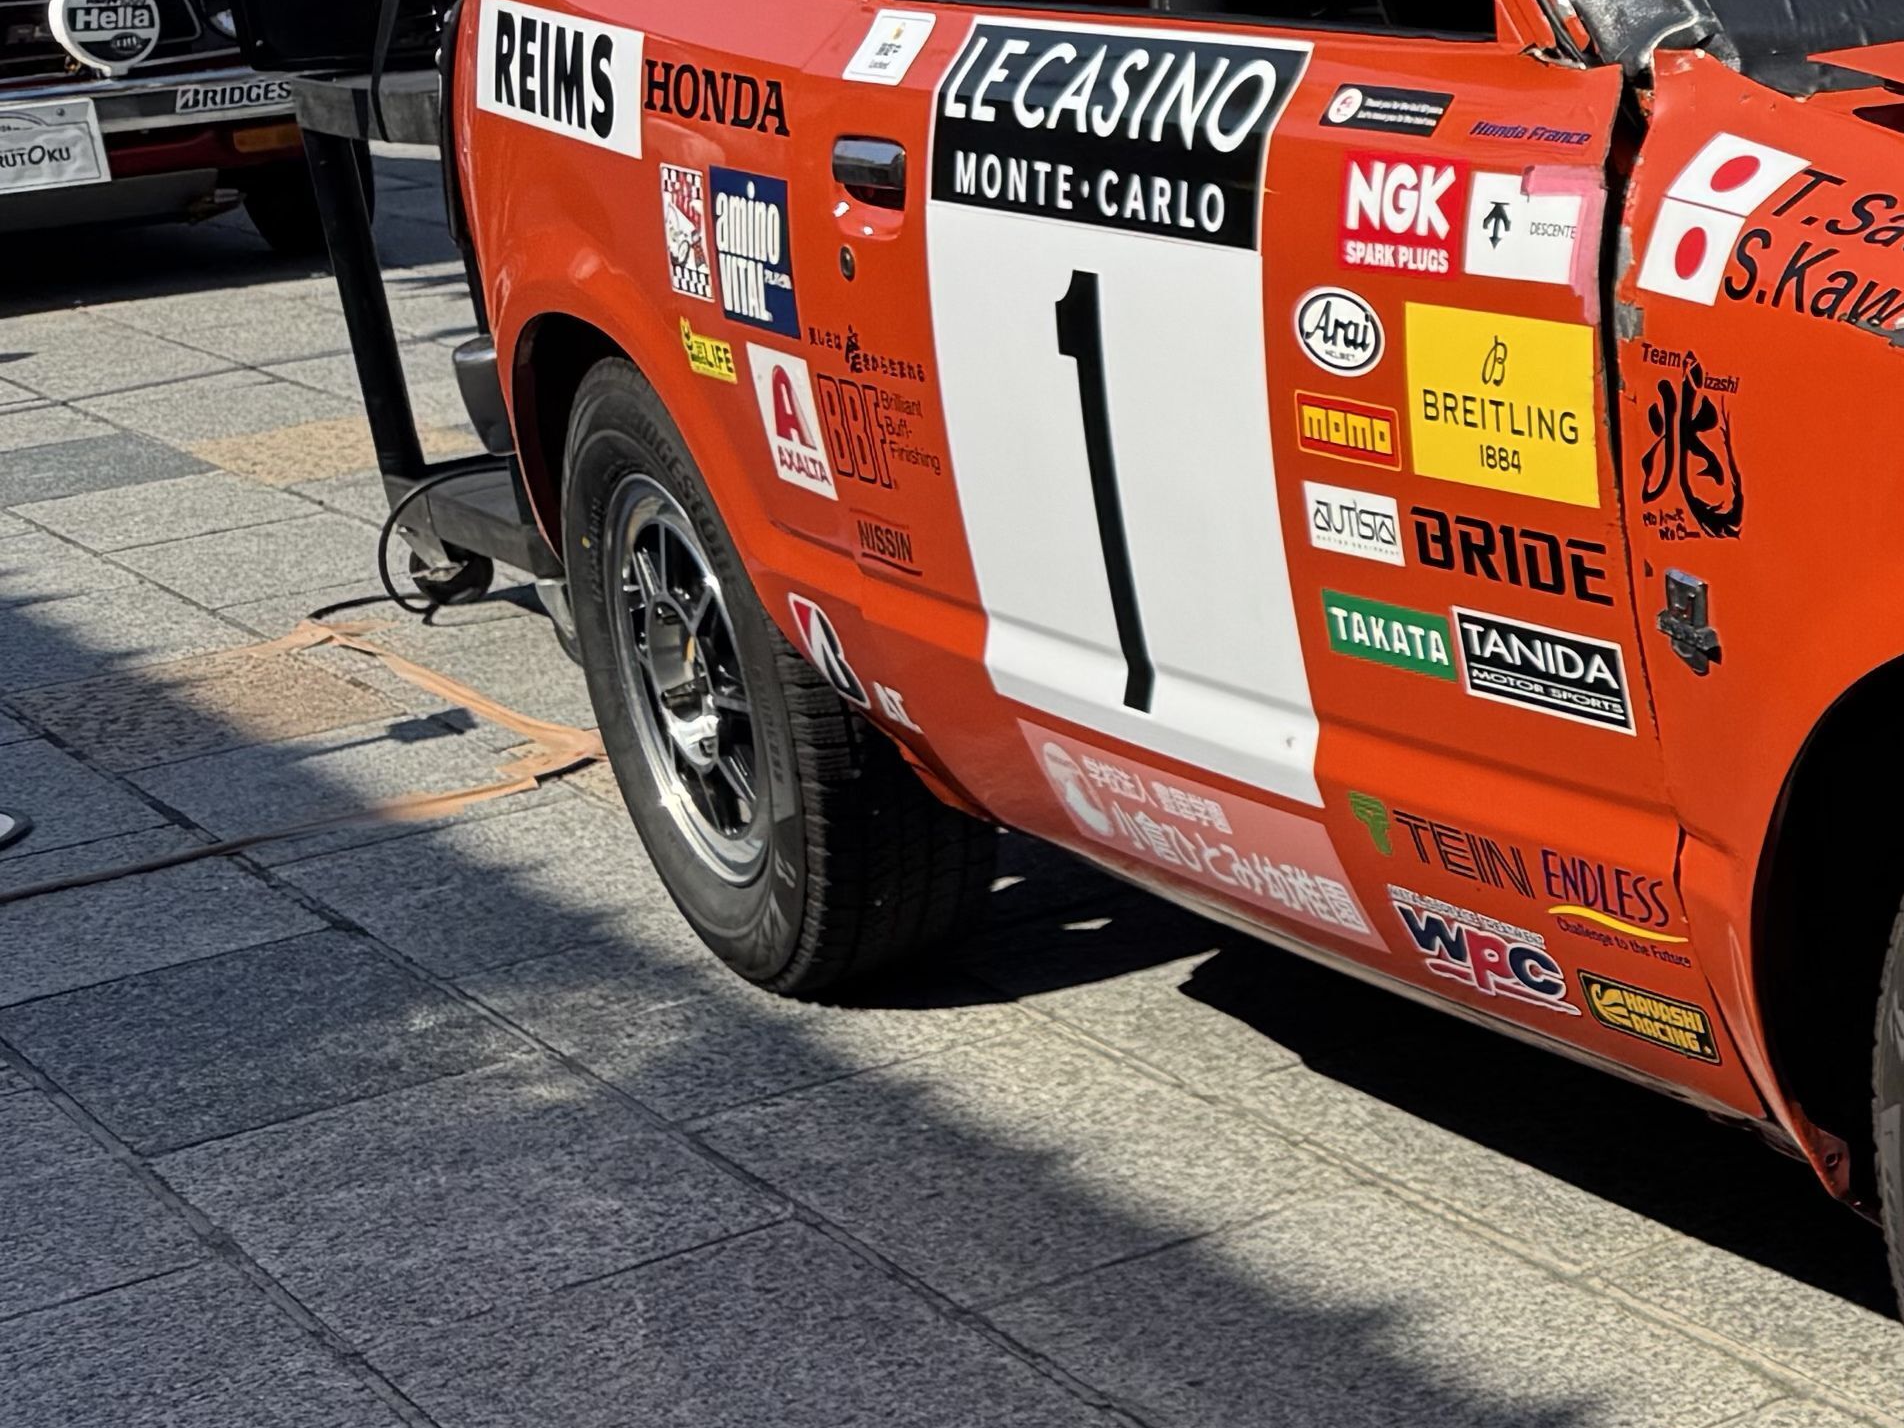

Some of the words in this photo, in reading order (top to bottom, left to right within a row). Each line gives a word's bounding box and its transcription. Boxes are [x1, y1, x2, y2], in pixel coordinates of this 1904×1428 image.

[76, 6, 150, 30] Hella
[180, 80, 291, 110] BRIDGES
[494, 9, 615, 140] REIMS
[644, 59, 790, 137] HONDA
[1469, 120, 1528, 141] Honda
[1529, 126, 1592, 147] France
[716, 180, 780, 265] amino
[1347, 160, 1456, 240] NGK
[1345, 240, 1394, 269] SPARK
[1397, 245, 1449, 274] PLUGS
[1530, 221, 1576, 240] DESCENTE
[720, 253, 773, 322] VITAL
[1305, 300, 1370, 352] Arai
[1641, 343, 1681, 368] Team
[816, 372, 893, 489] BBF
[880, 391, 923, 418] Brilliant
[1423, 389, 1579, 445] BREITLING
[778, 446, 831, 486] AXALTA
[886, 438, 941, 476] Finishing
[1480, 444, 1521, 473] 1884
[1052, 268, 1150, 718] 1
[857, 519, 914, 563] NISSIN
[1410, 506, 1615, 607] BRIDE
[1328, 606, 1449, 666] TAKATA
[1461, 622, 1619, 690] TANIDA
[1471, 669, 1544, 694] MOTOR
[1551, 684, 1625, 714] SPORTS
[1112, 801, 1371, 934] 小倉ひとみ幼稚園
[1393, 809, 1537, 900] TEIN
[1541, 849, 1670, 927] ENDLESS
[1394, 901, 1568, 998] WPC
[1556, 915, 1615, 946] Challenge
[1615, 935, 1630, 951] to
[1630, 941, 1651, 957] the
[1651, 945, 1692, 968] Future
[1625, 990, 1705, 1034] HAYASHI
[1629, 1013, 1700, 1053] RACING
